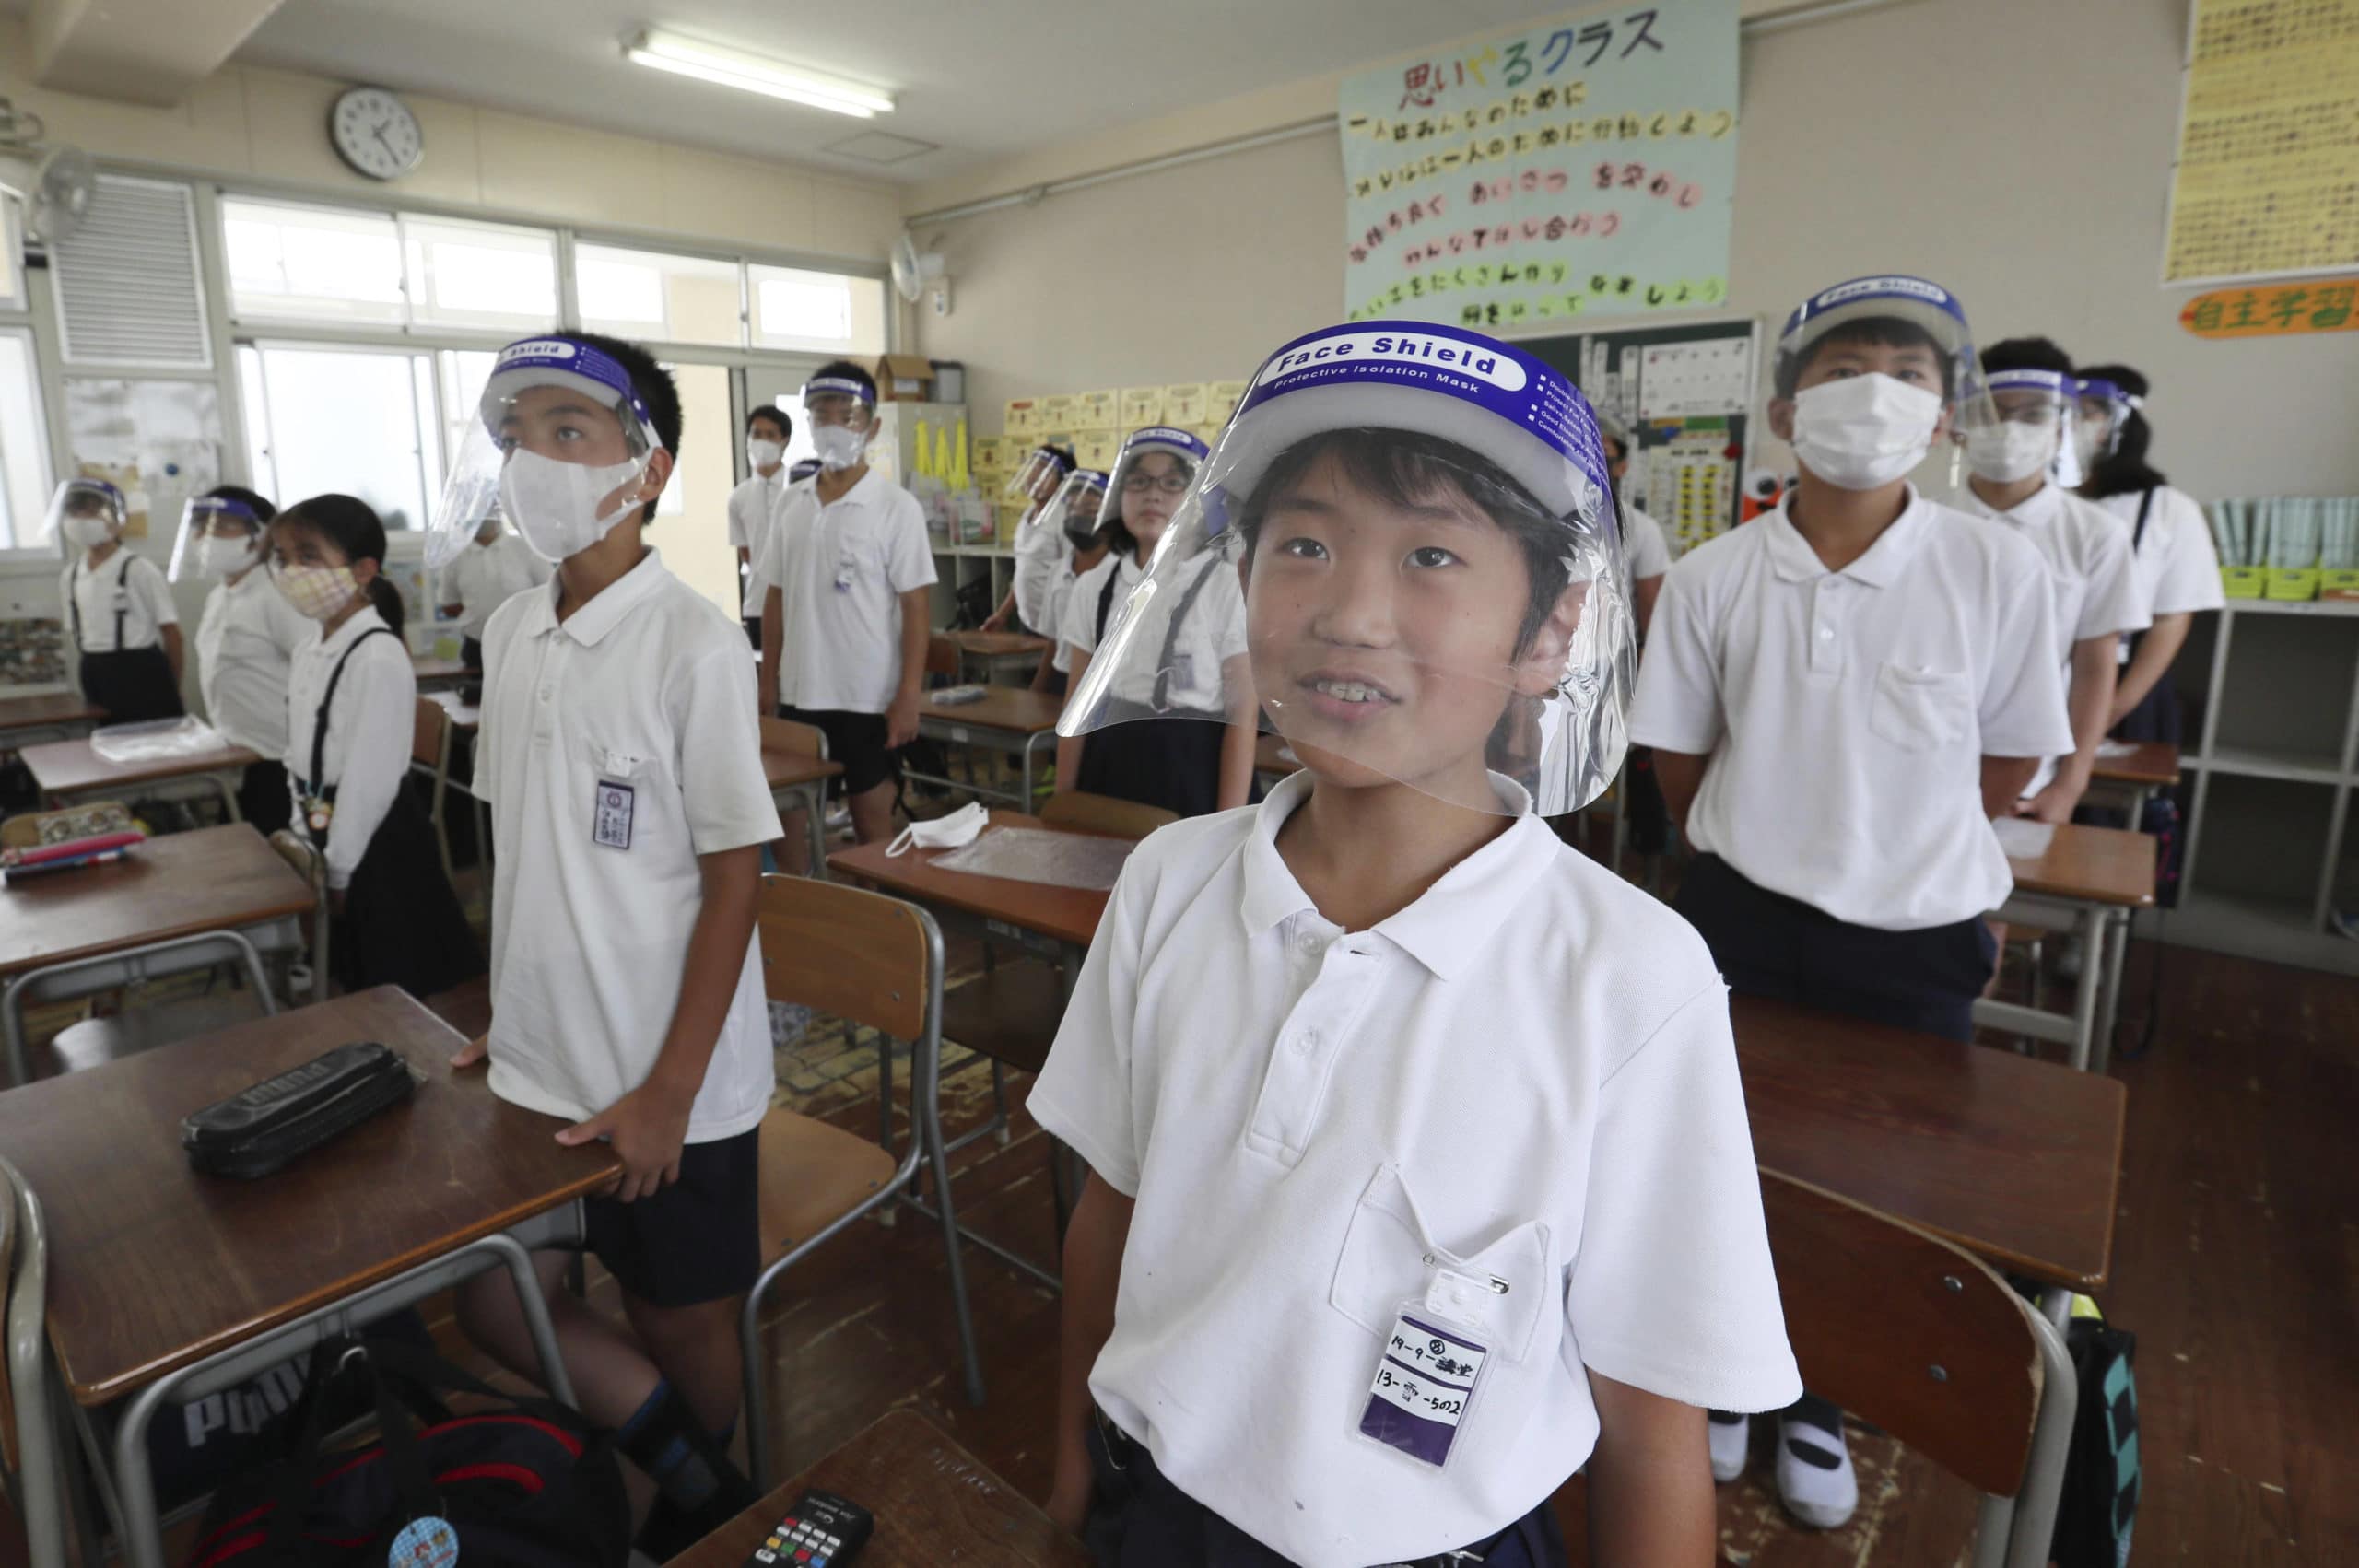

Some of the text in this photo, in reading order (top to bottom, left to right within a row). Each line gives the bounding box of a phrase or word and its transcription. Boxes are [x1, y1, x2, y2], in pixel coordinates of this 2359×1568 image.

[1278, 336, 1497, 375] Face Shield
[1274, 364, 1480, 394] Protective Isolation Mask
